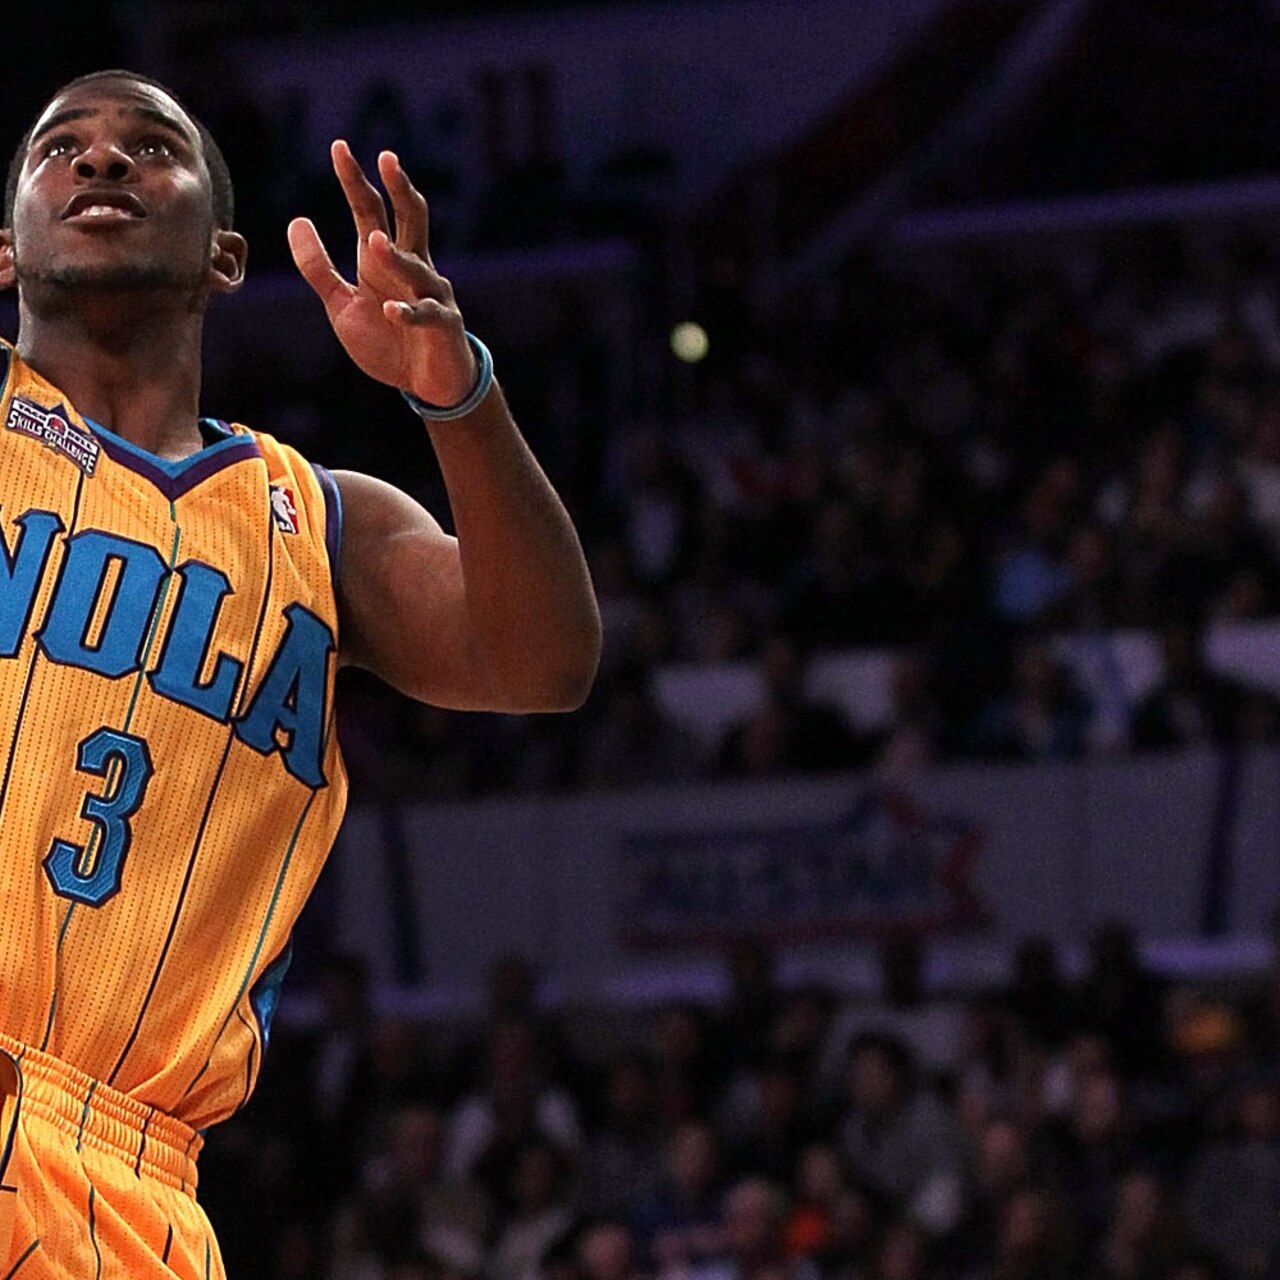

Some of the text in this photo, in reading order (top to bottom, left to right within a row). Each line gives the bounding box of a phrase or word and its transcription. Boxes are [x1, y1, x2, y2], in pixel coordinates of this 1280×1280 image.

[7, 410, 97, 474] SKILLS CHALLENGE
[42, 725, 155, 908] 3
